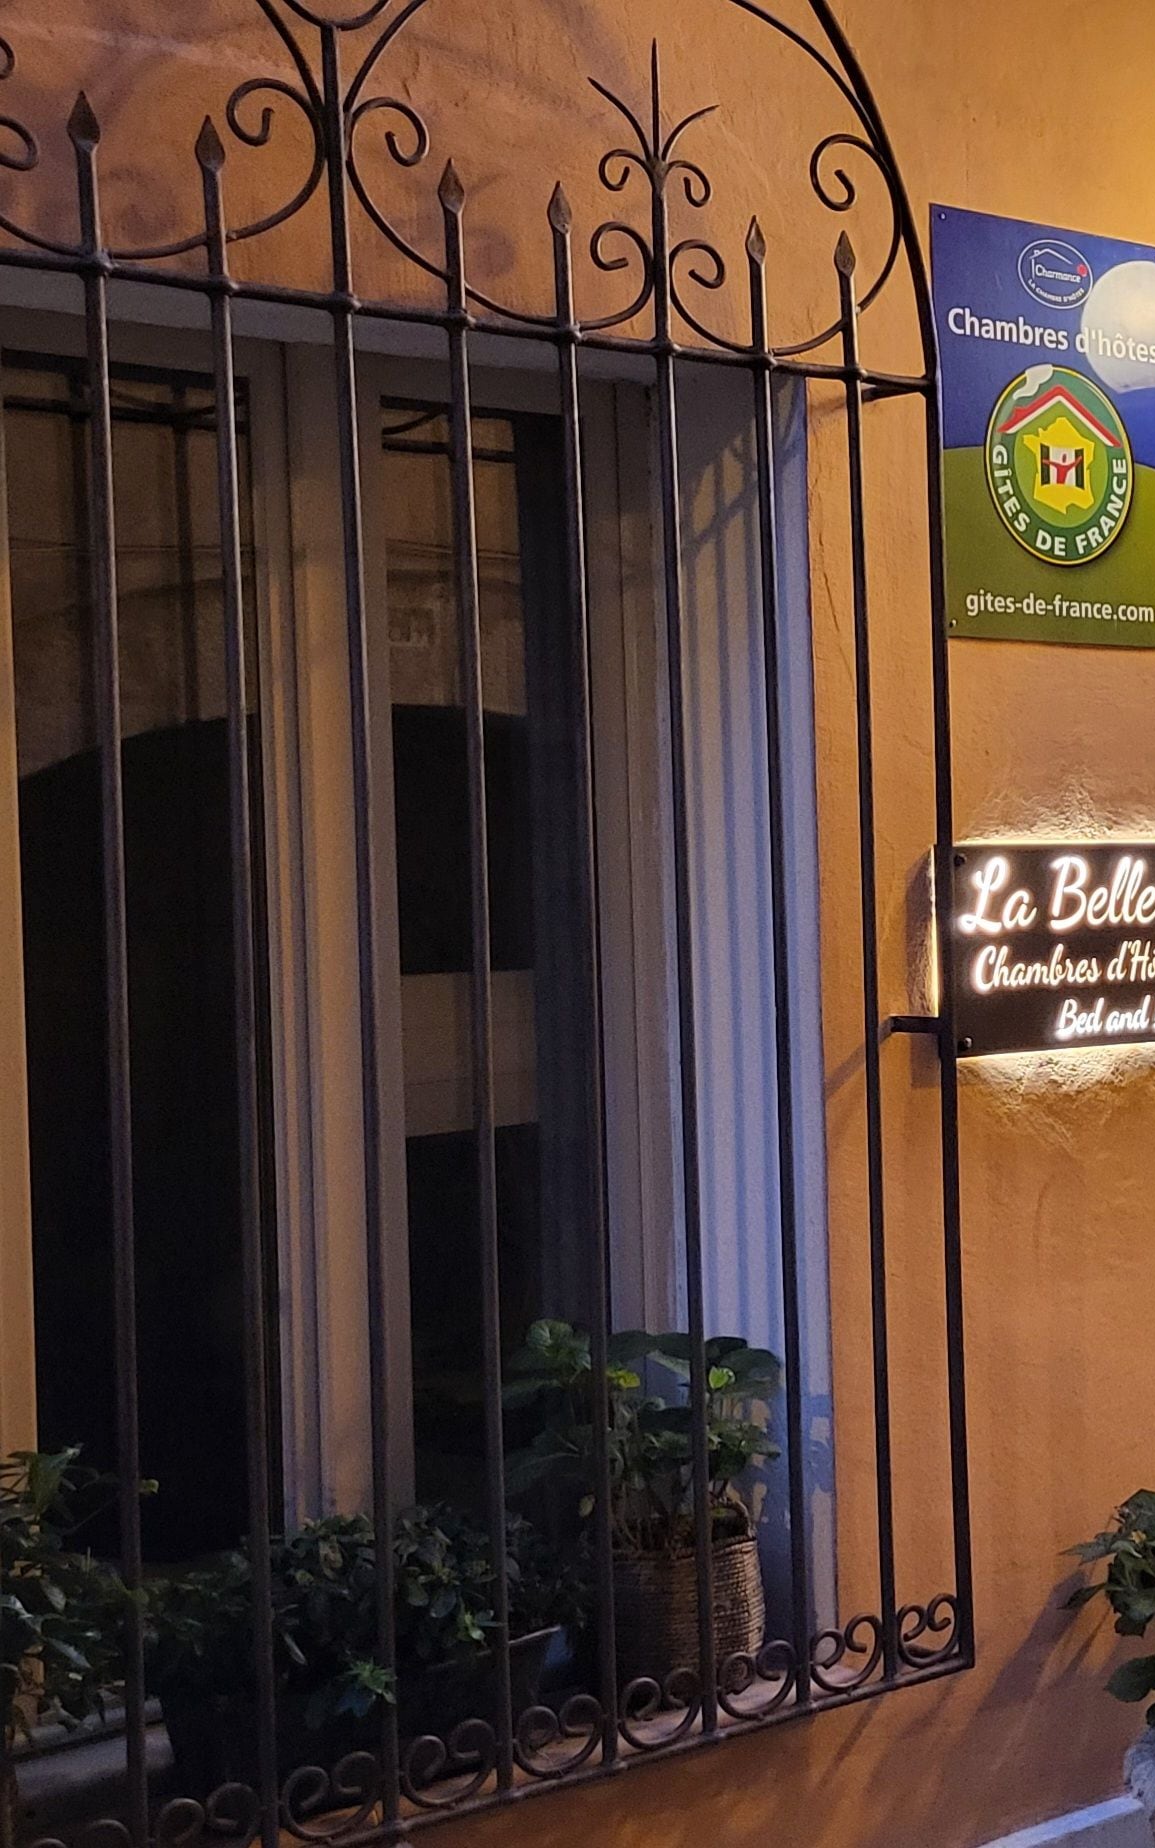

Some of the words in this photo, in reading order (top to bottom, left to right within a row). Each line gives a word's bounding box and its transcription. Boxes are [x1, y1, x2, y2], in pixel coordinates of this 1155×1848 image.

[1035, 264, 1081, 283] Charmance
[947, 307, 1069, 350] Chambres
[992, 444, 1030, 533] GÎTES
[1035, 529, 1067, 557] DE
[1075, 458, 1127, 555] FRANCE
[966, 588, 1155, 623] gites-de-france.com
[959, 856, 1038, 934] La
[974, 943, 1103, 992] Chambres
[1055, 997, 1105, 1041] Bed
[1105, 994, 1151, 1033] and
